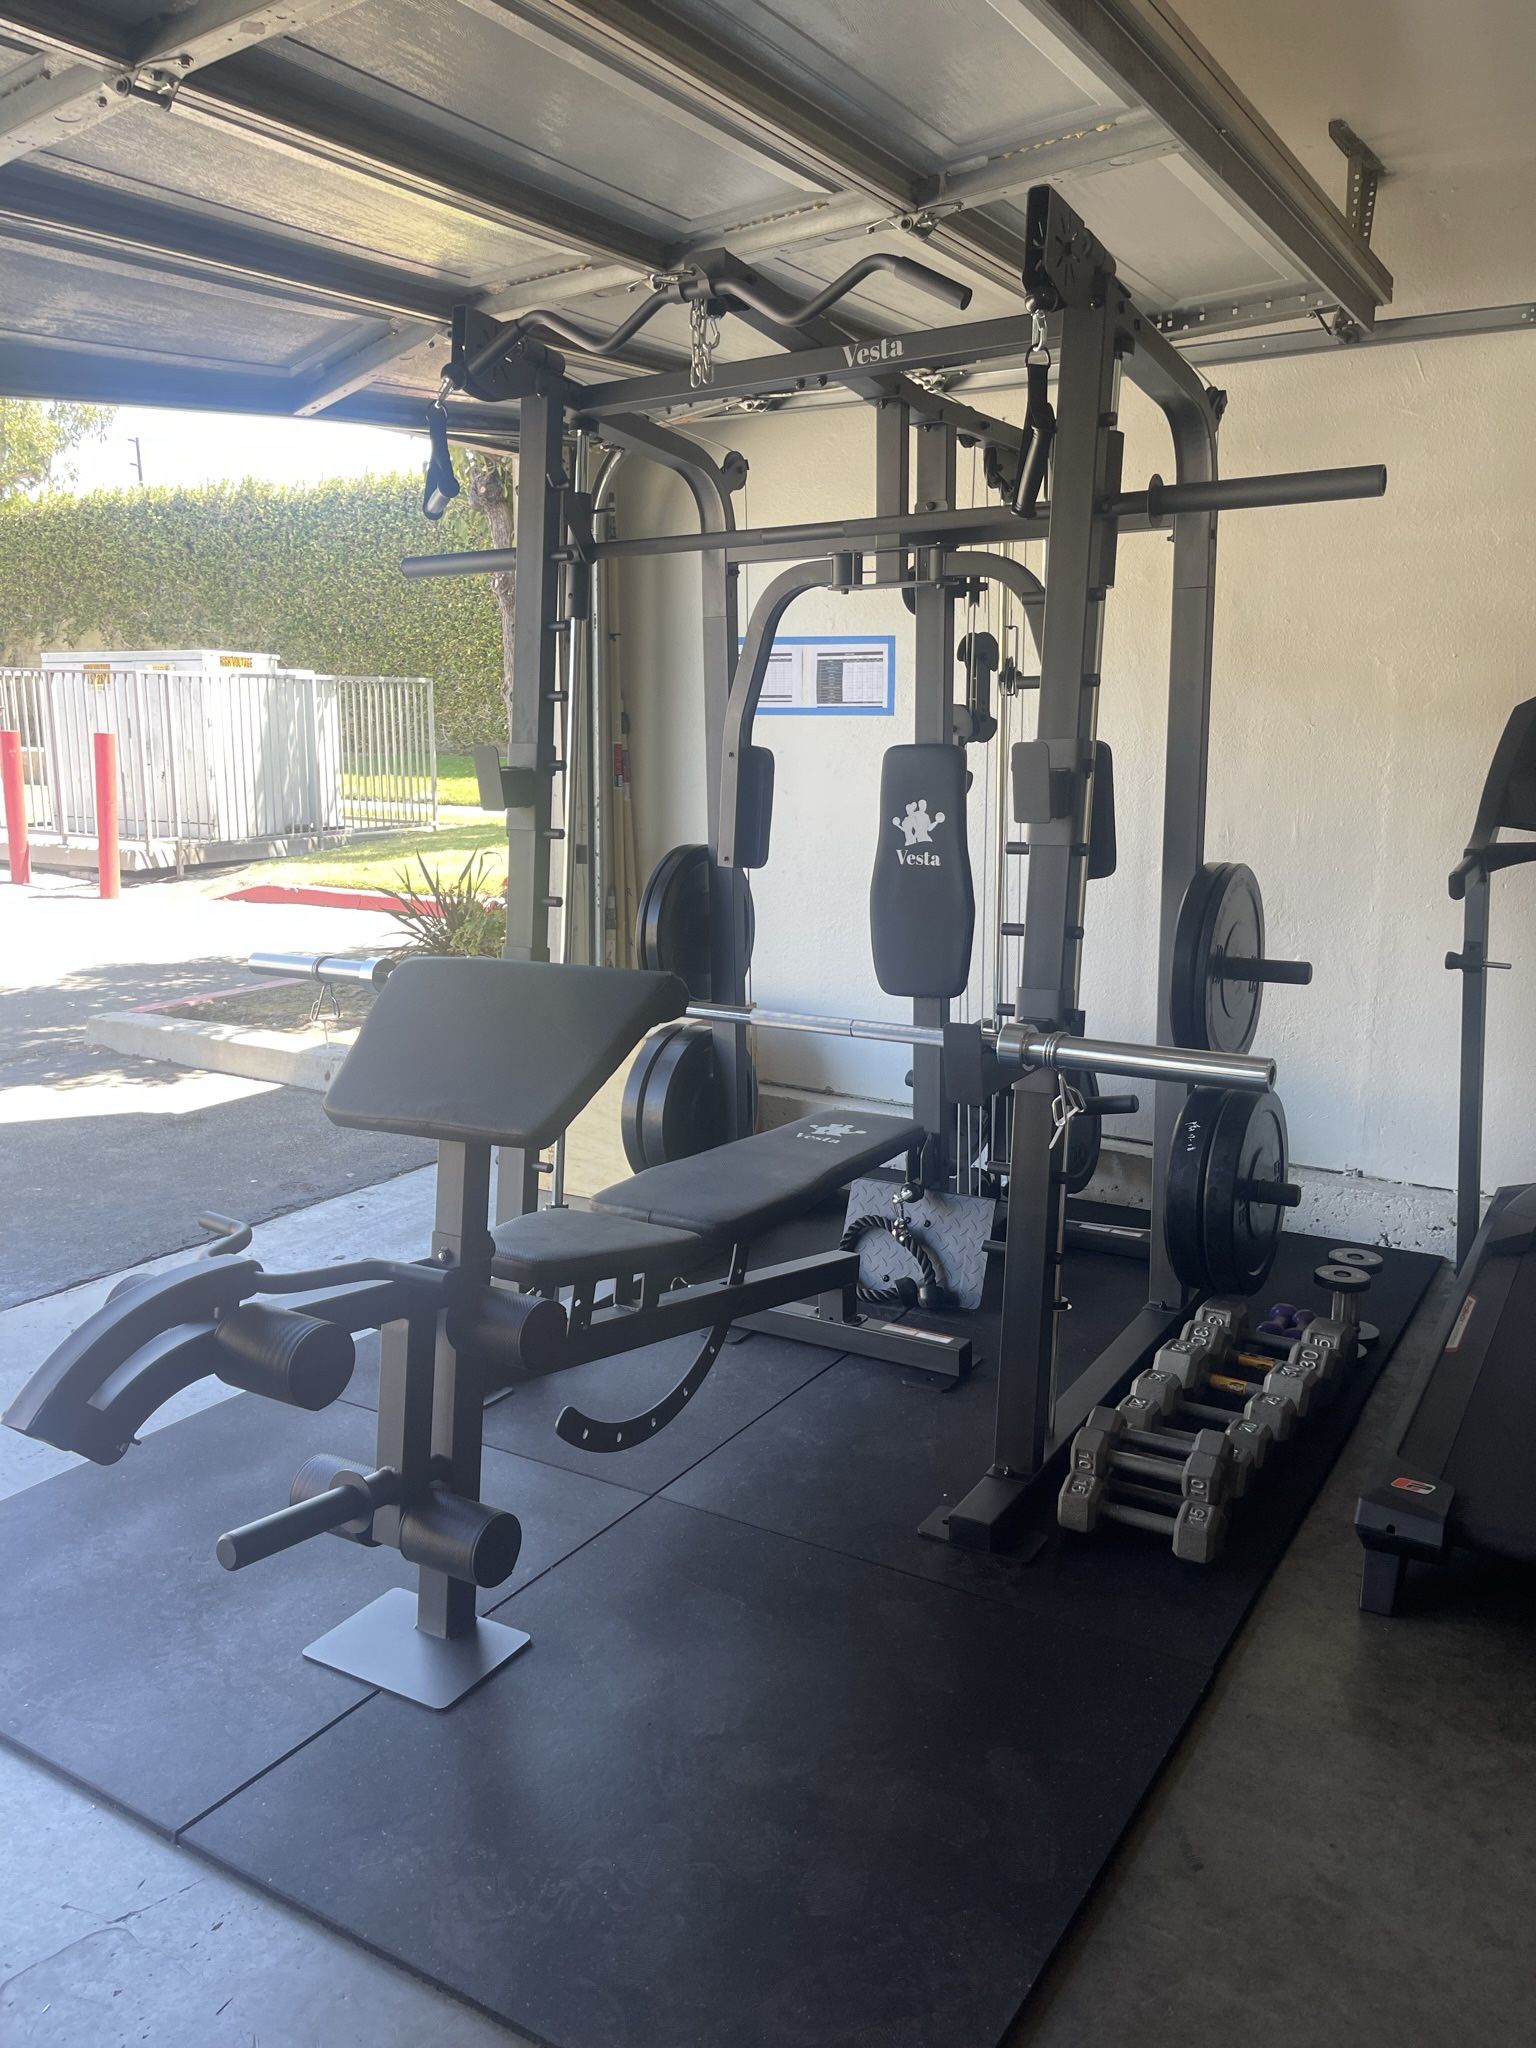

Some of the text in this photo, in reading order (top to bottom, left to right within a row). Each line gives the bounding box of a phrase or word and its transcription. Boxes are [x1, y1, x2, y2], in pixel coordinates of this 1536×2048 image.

[842, 338, 904, 368] Vesta
[895, 849, 942, 867] Vesta
[1190, 1326, 1209, 1346] 30
[1299, 1350, 1319, 1370] 30
[1078, 1453, 1091, 1469] 10
[1071, 1480, 1088, 1495] 15
[1190, 1478, 1205, 1495] 10
[1188, 1507, 1206, 1524] 15
